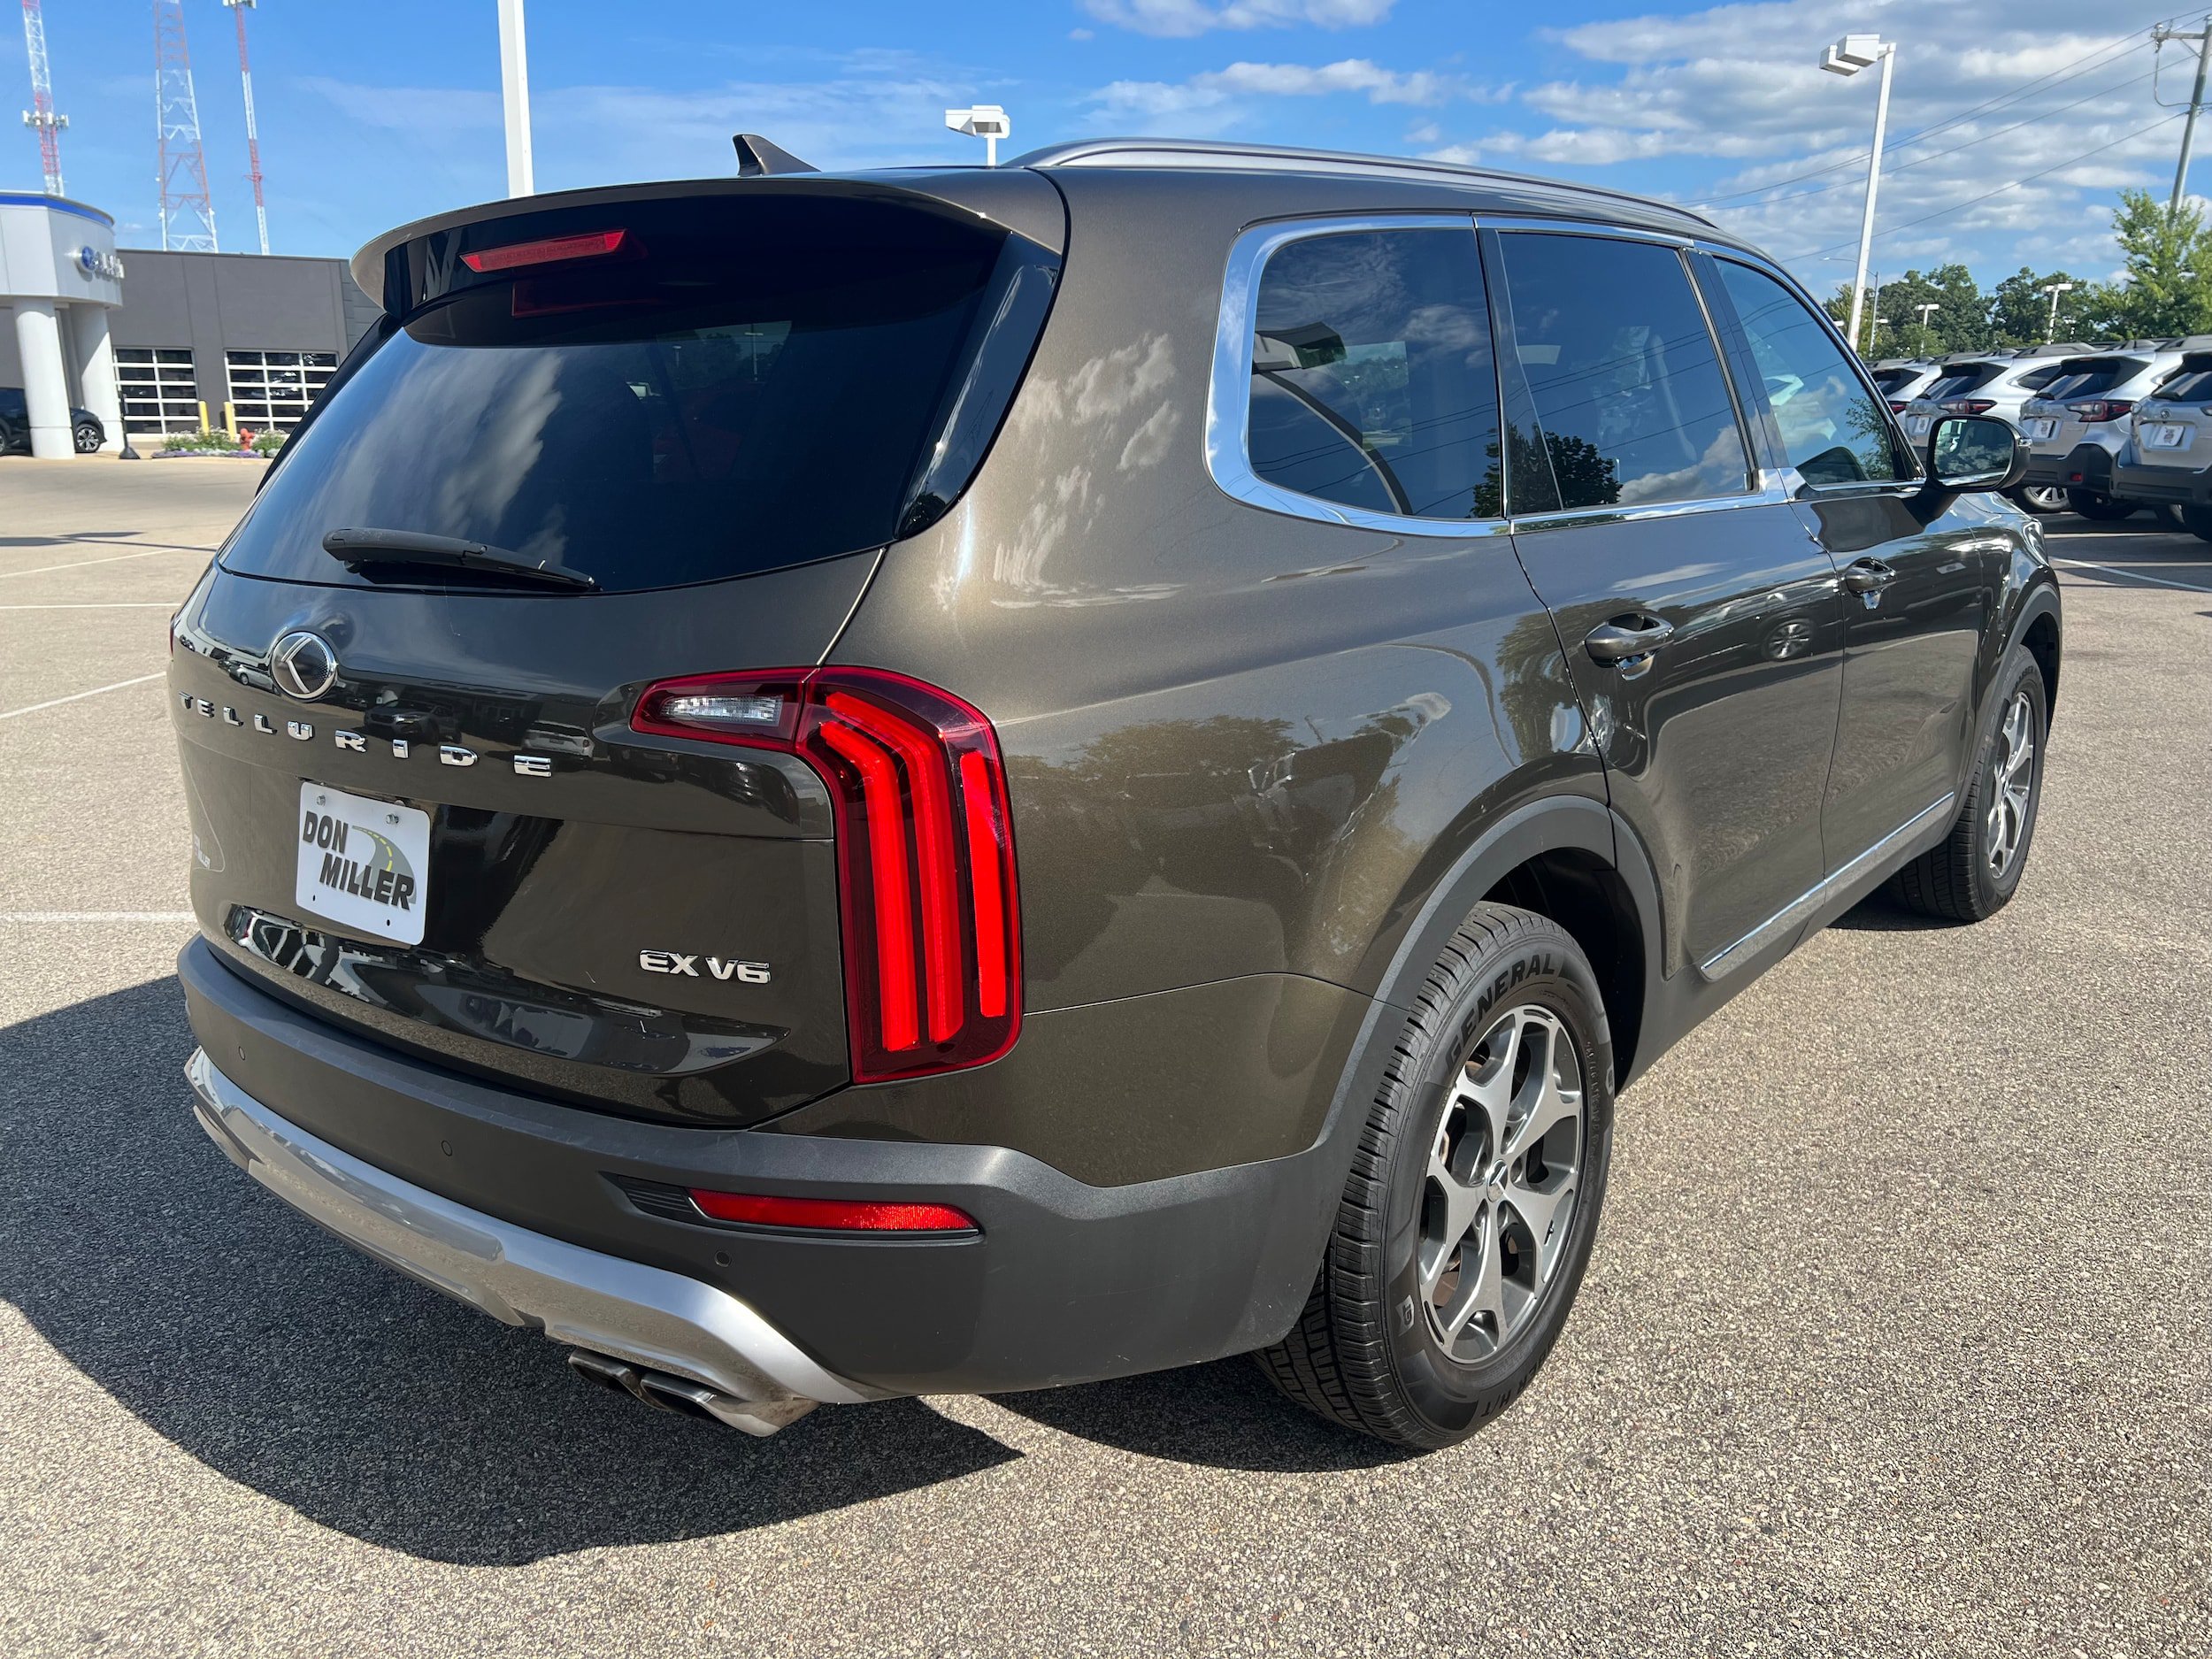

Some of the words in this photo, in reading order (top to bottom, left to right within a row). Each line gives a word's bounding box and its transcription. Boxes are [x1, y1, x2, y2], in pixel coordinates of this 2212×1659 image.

[179, 691, 552, 778] TELLURIDE
[303, 810, 349, 855] DON
[319, 852, 415, 911] MILLER
[640, 949, 700, 978] EX
[705, 956, 772, 985] V6
[1445, 953, 1556, 1077] GENERAL
